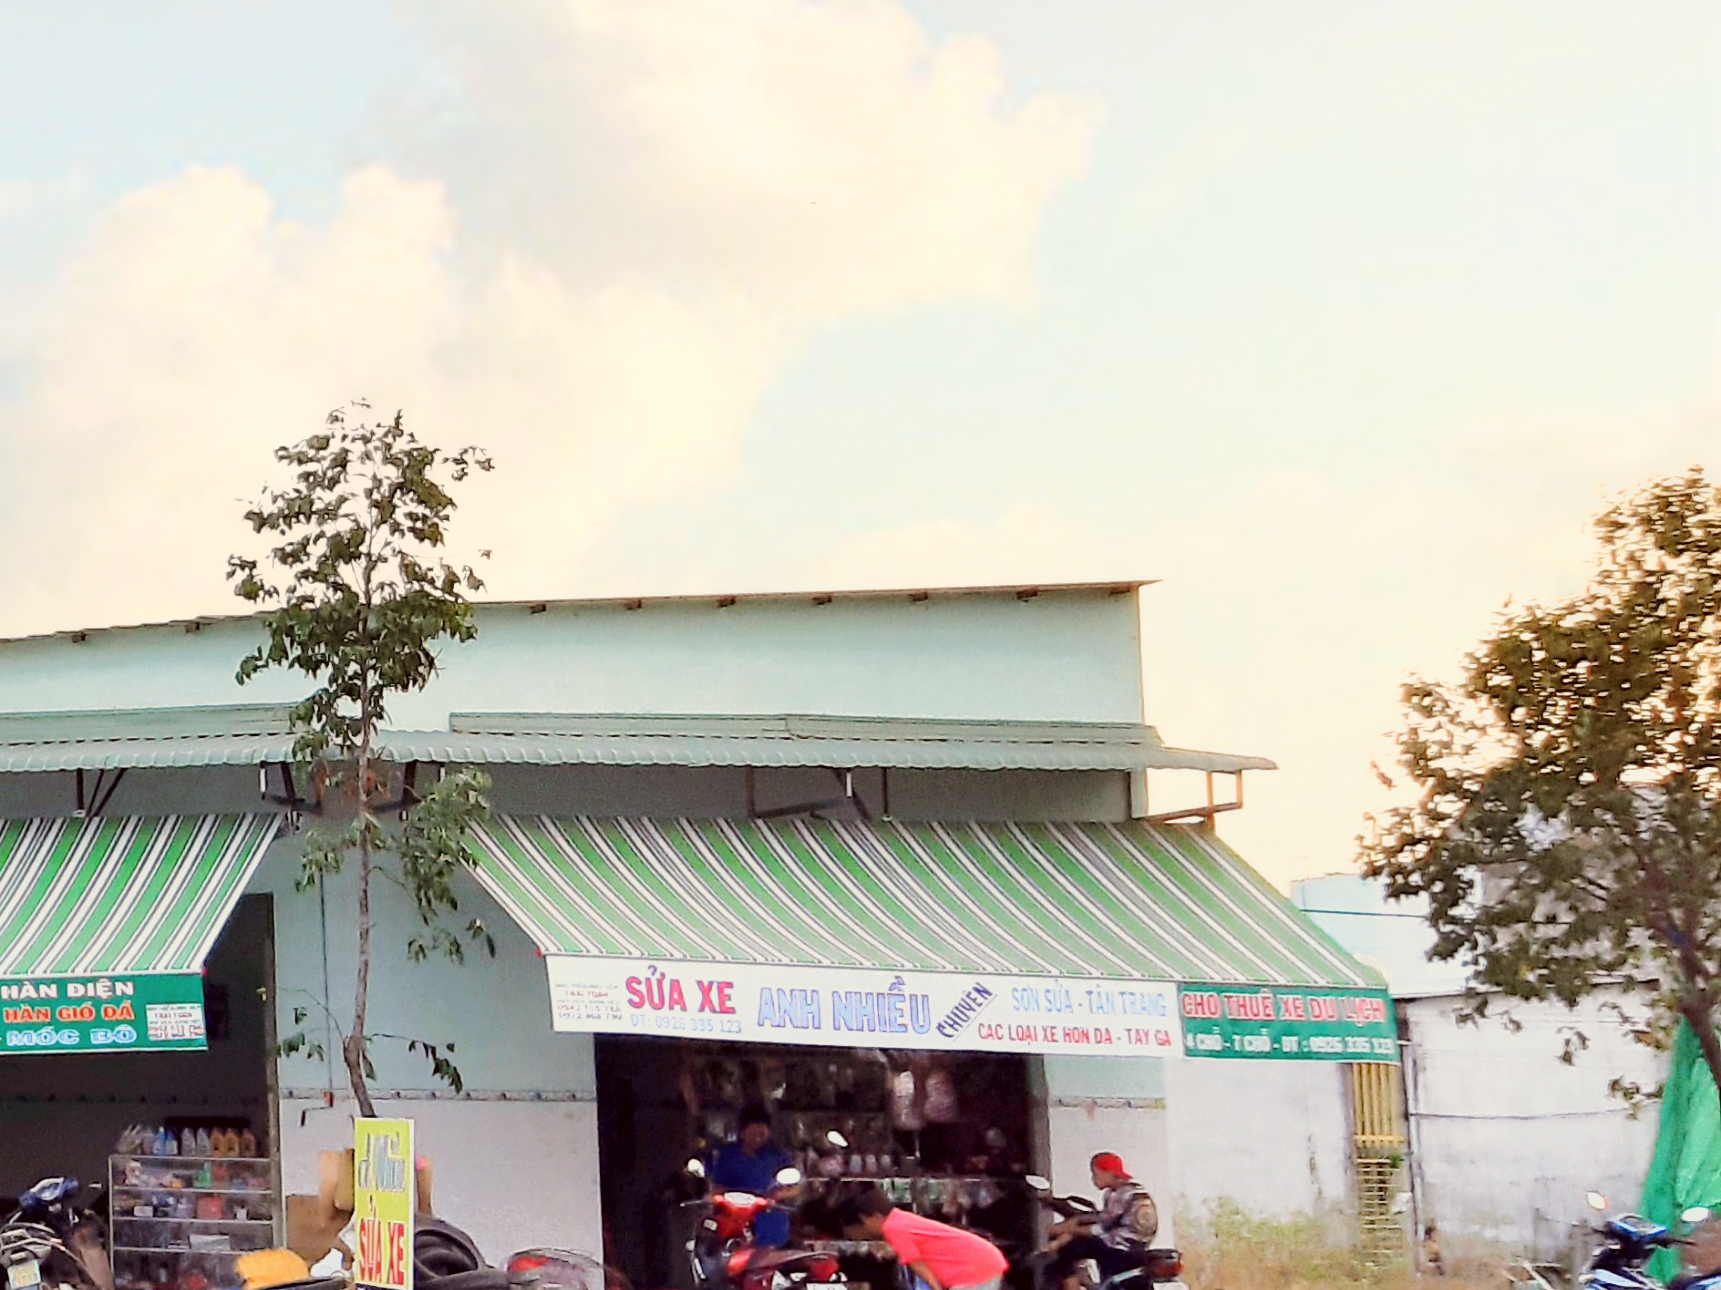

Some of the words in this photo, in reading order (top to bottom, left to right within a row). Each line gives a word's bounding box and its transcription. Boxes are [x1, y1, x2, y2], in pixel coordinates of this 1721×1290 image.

[0, 981, 58, 1000] HÀN
[625, 965, 687, 1012] SỬA
[695, 980, 736, 1014] XE
[3, 1003, 51, 1023] HÀN
[757, 987, 822, 1030] ANH
[1118, 991, 1167, 1016] TRANG
[1182, 992, 1220, 1019] CHO
[1222, 988, 1276, 1020] THUÊ
[1277, 994, 1305, 1021] XE
[1309, 995, 1338, 1021] DU
[719, 1020, 742, 1034] 123
[1041, 1025, 1058, 1043] XE
[1125, 1028, 1150, 1045] TAY
[1155, 1029, 1173, 1046] GA
[387, 1221, 405, 1286] XE
